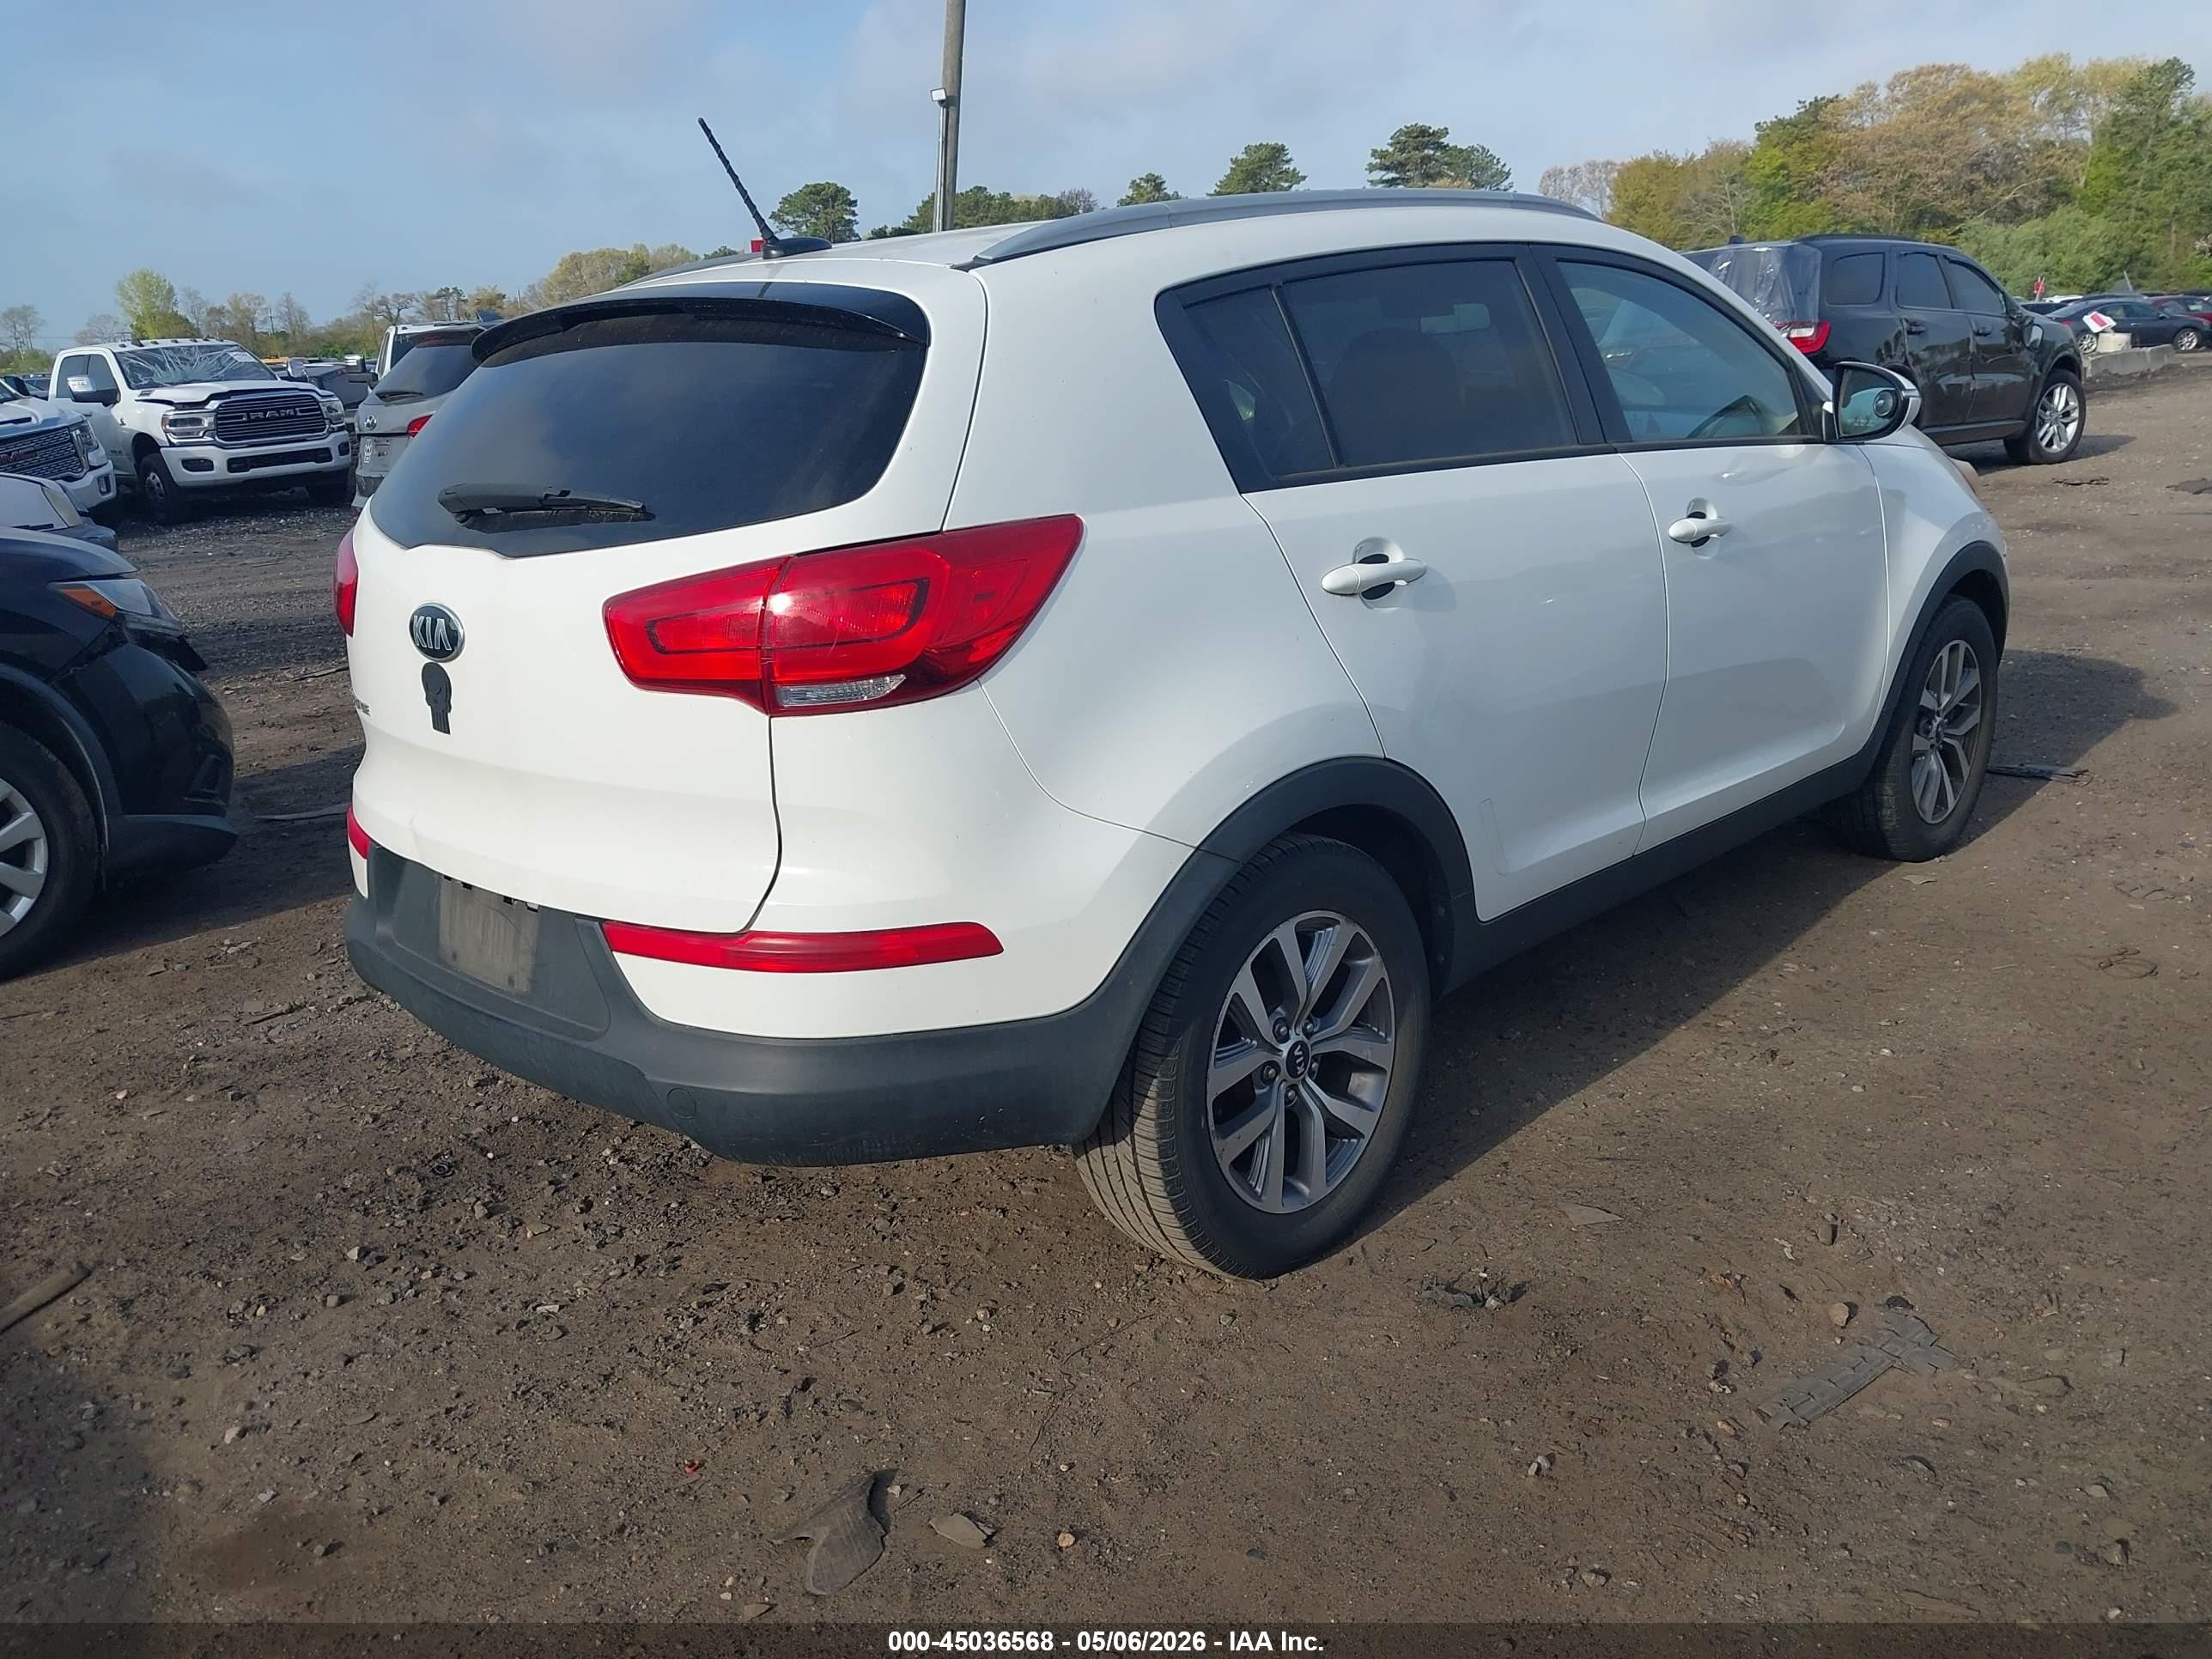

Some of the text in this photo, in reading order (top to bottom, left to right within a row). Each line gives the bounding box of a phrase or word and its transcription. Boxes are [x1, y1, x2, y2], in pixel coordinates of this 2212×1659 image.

[249, 409, 294, 420] RAM
[413, 615, 453, 651] KIA
[1293, 1043, 1305, 1075] KIA
